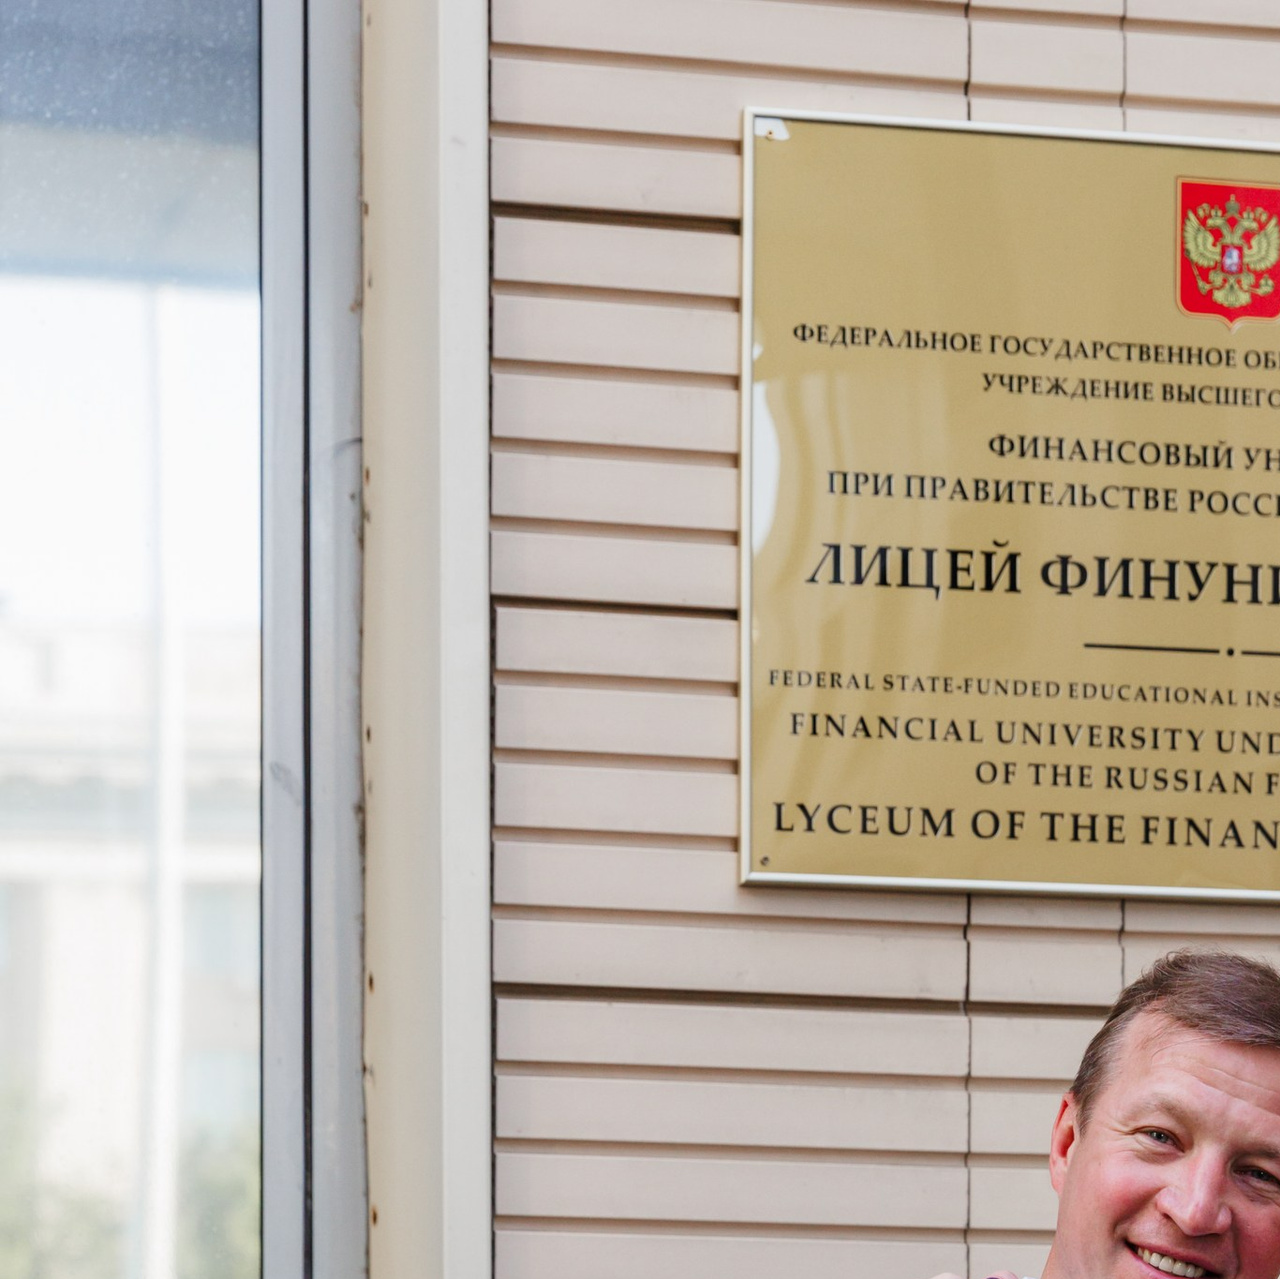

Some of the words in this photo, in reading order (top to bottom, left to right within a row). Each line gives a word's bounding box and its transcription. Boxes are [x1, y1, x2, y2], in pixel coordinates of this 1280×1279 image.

[792, 322, 982, 354] ФЕДЕРАЛЬНОЕ
[989, 334, 1237, 369] ГОСУДАРСТВЕННОЕ
[982, 372, 1154, 402] УЧРЕЖДЕНИЕ
[987, 433, 1234, 471] ФИНАНСОВЫЙ
[828, 470, 894, 498] ПРИ
[904, 474, 1178, 513] ПРАВИТЕЛЬСТВЕ
[804, 540, 1022, 601] ЛИЦЕЙ
[768, 669, 875, 692] FEDERAL
[882, 673, 1061, 698] STATE-FUNDED
[1068, 681, 1238, 707] EDUCATIONAL
[790, 712, 984, 744] FINANCIAL
[995, 720, 1205, 753] UNIVERSITY
[974, 760, 1017, 786] OF
[1027, 762, 1093, 789] THE
[1104, 765, 1254, 795] RUSSIAN
[772, 801, 956, 839] LYCEUM
[970, 808, 1026, 841] OF
[1039, 811, 1126, 845] THE
